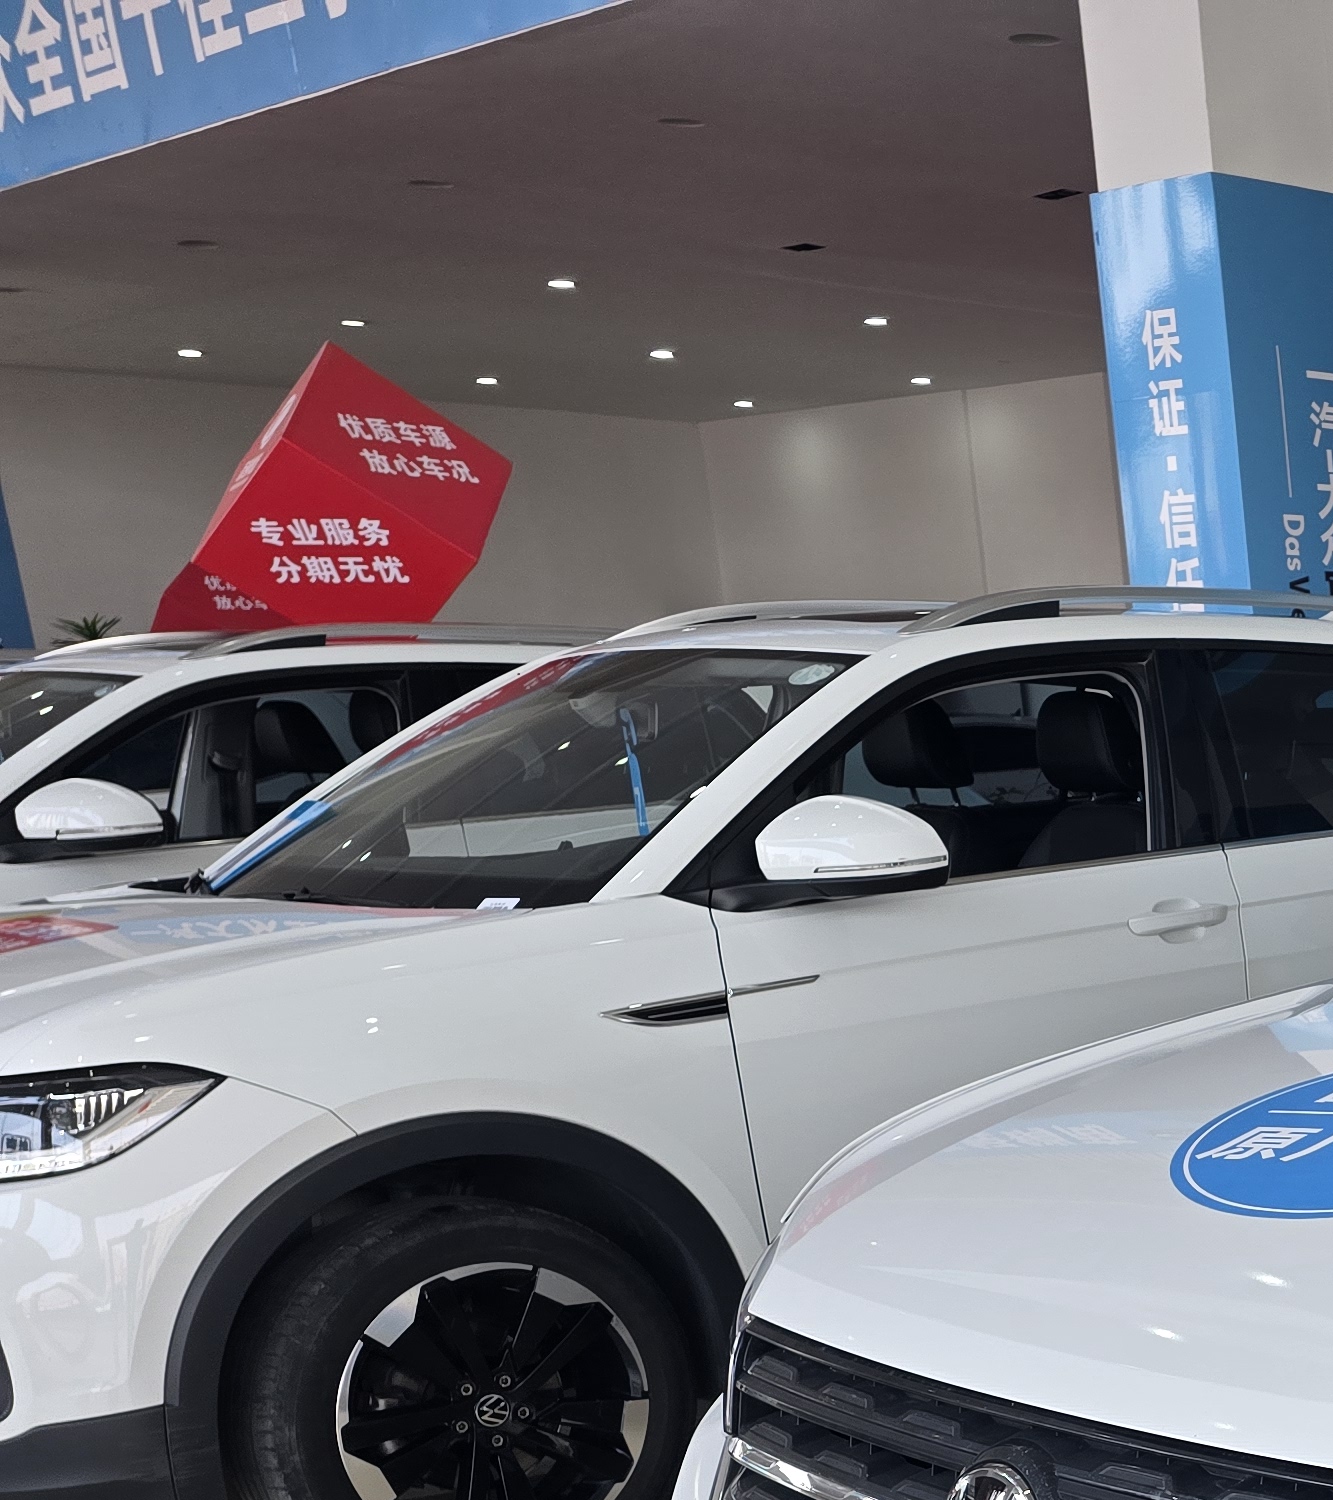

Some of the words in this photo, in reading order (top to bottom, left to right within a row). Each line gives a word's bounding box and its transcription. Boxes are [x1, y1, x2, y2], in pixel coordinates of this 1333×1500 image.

[337, 412, 457, 450] 优质车源
[360, 448, 480, 484] 放心车况
[250, 517, 390, 547] 专业服务
[1283, 513, 1305, 571] Das
[269, 555, 410, 584] 分期无忧
